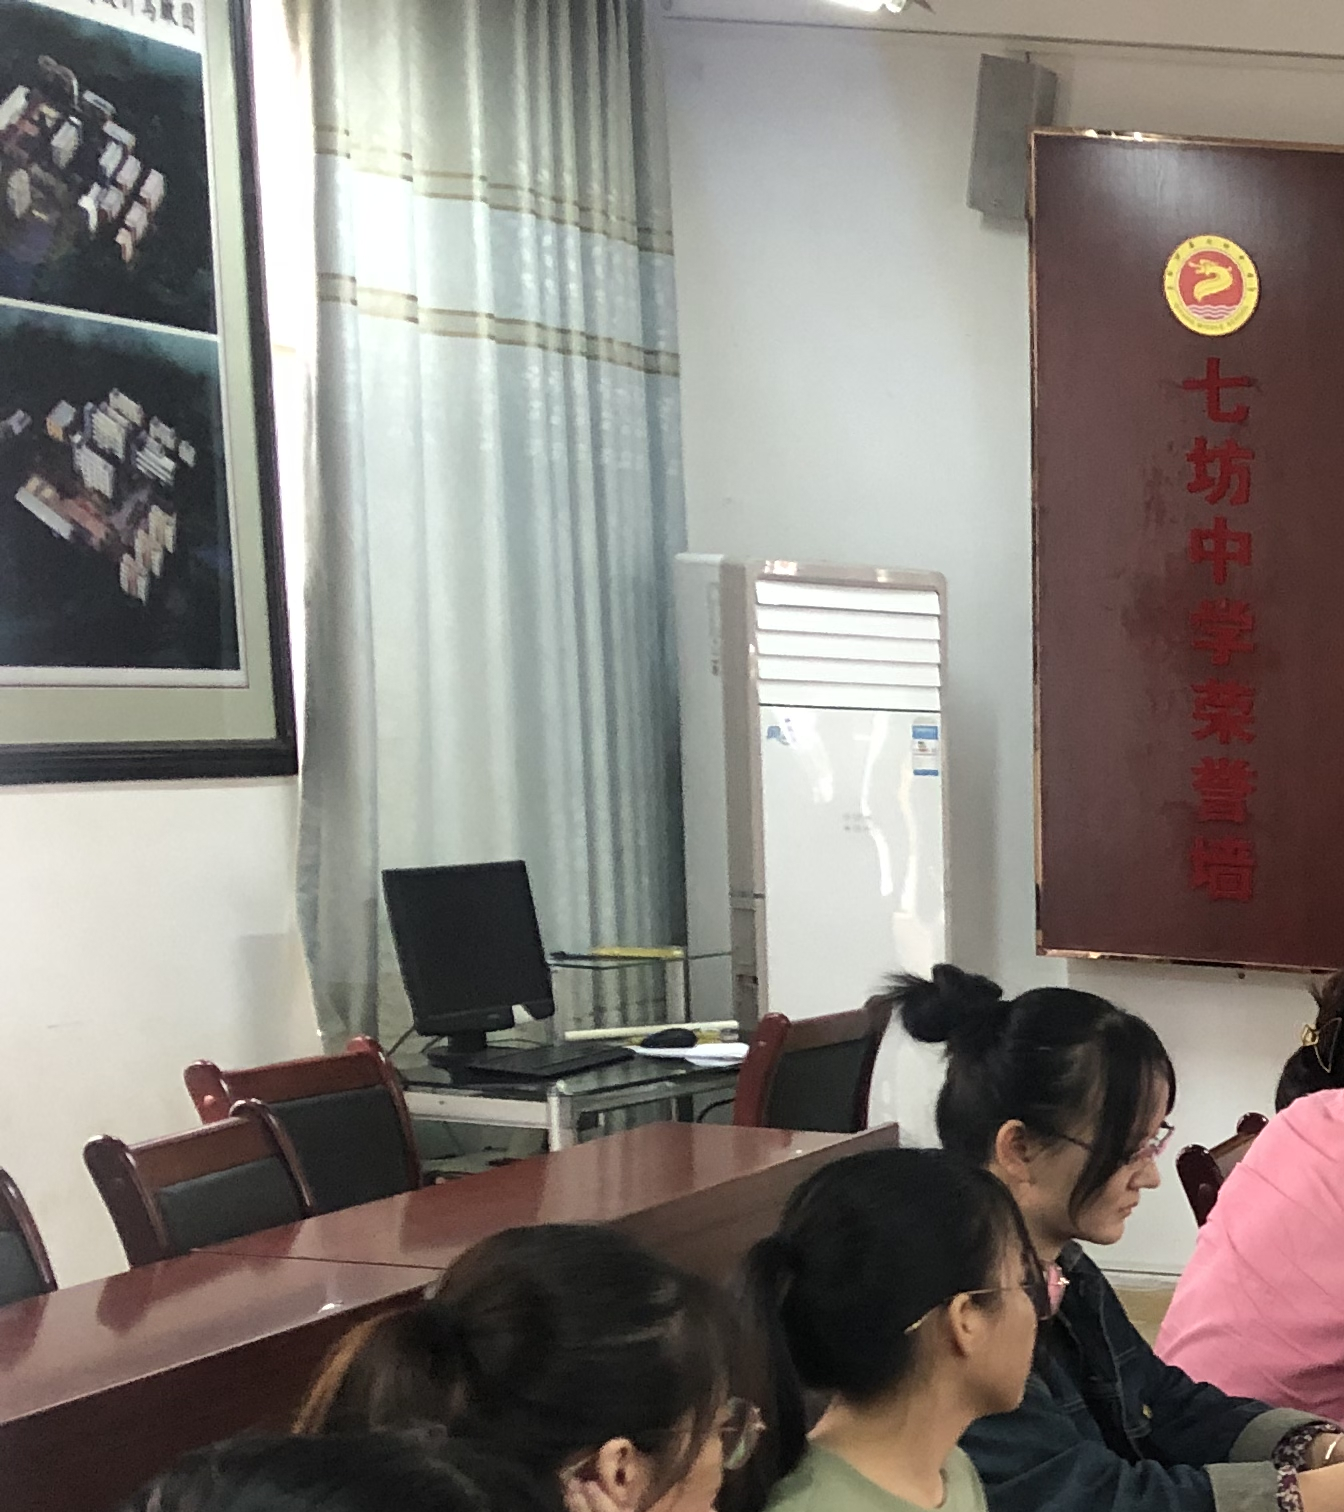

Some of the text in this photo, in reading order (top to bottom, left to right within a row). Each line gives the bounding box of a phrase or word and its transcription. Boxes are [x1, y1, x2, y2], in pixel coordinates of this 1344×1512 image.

[1182, 357, 1257, 902] 七坊中学荣誉墙
